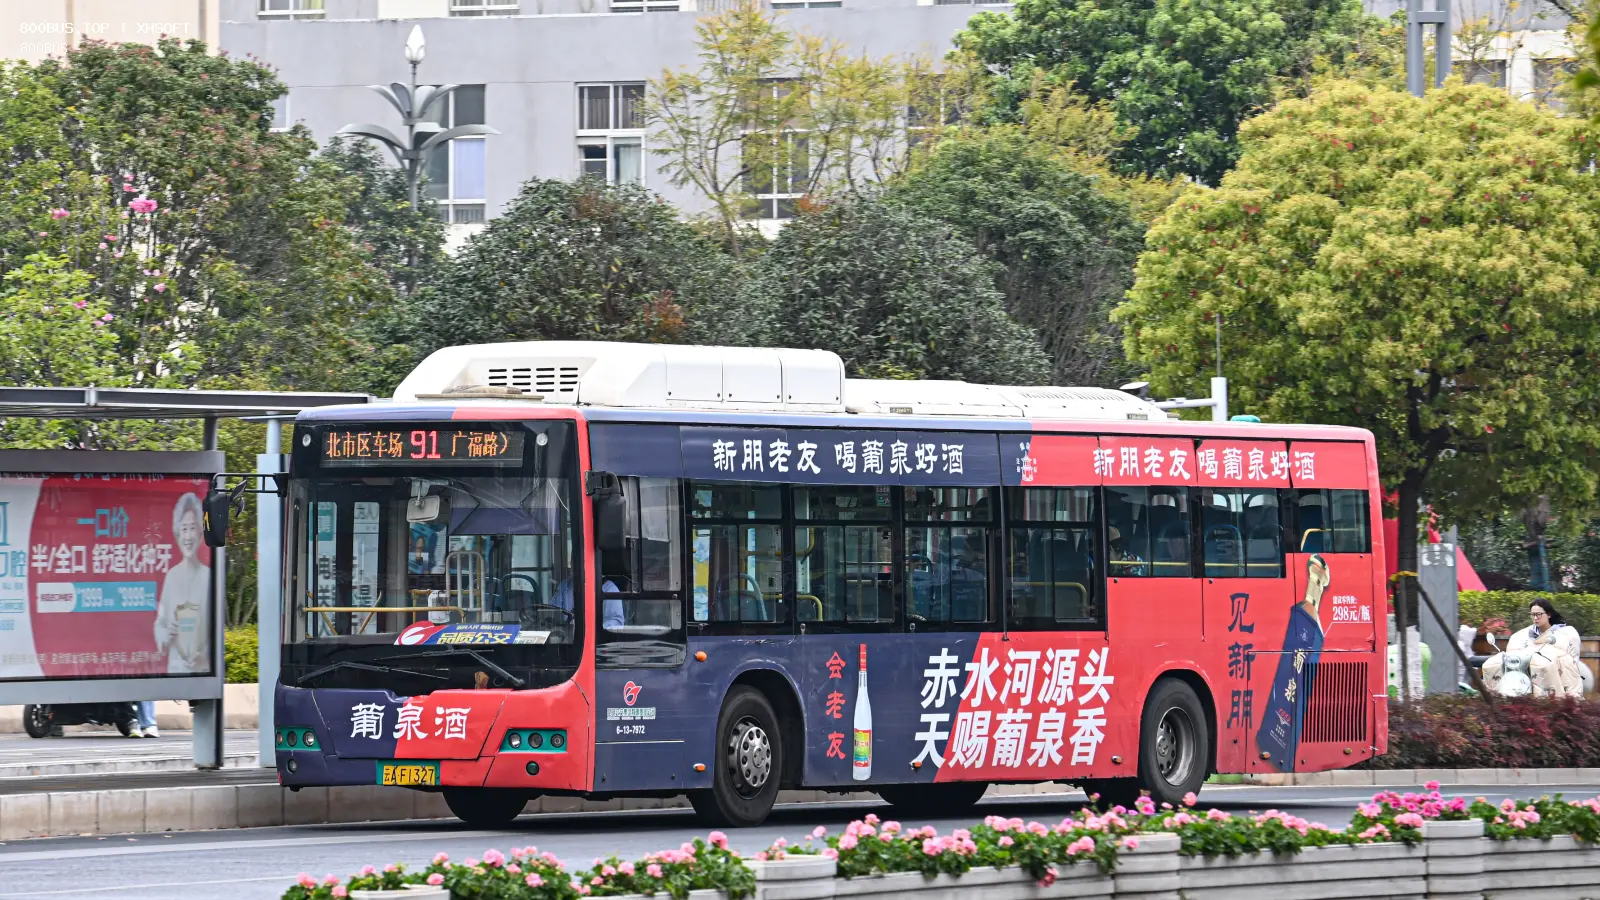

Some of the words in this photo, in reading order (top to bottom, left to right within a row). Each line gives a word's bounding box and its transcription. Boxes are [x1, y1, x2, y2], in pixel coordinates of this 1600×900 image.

[325, 431, 404, 458] 北市区车场
[410, 430, 441, 459] 91
[712, 437, 822, 474] 新朋老友
[833, 439, 964, 476] 喝葡泉好酒
[1092, 445, 1191, 480] 新朋老友
[1196, 447, 1316, 481] 喝葡泉好酒
[76, 506, 130, 538] 一口价
[31, 543, 87, 575] 半/全口
[91, 543, 173, 574] 舒适化种牙
[1332, 604, 1371, 622] 298元/瓶
[437, 632, 513, 645] 品质公交
[920, 647, 1115, 709] 赤水河源头
[1226, 592, 1256, 729] 见新朋
[350, 702, 472, 741] 葡泉酒
[825, 651, 847, 760] 会老友
[912, 706, 1108, 769] 天赐葡泉香
